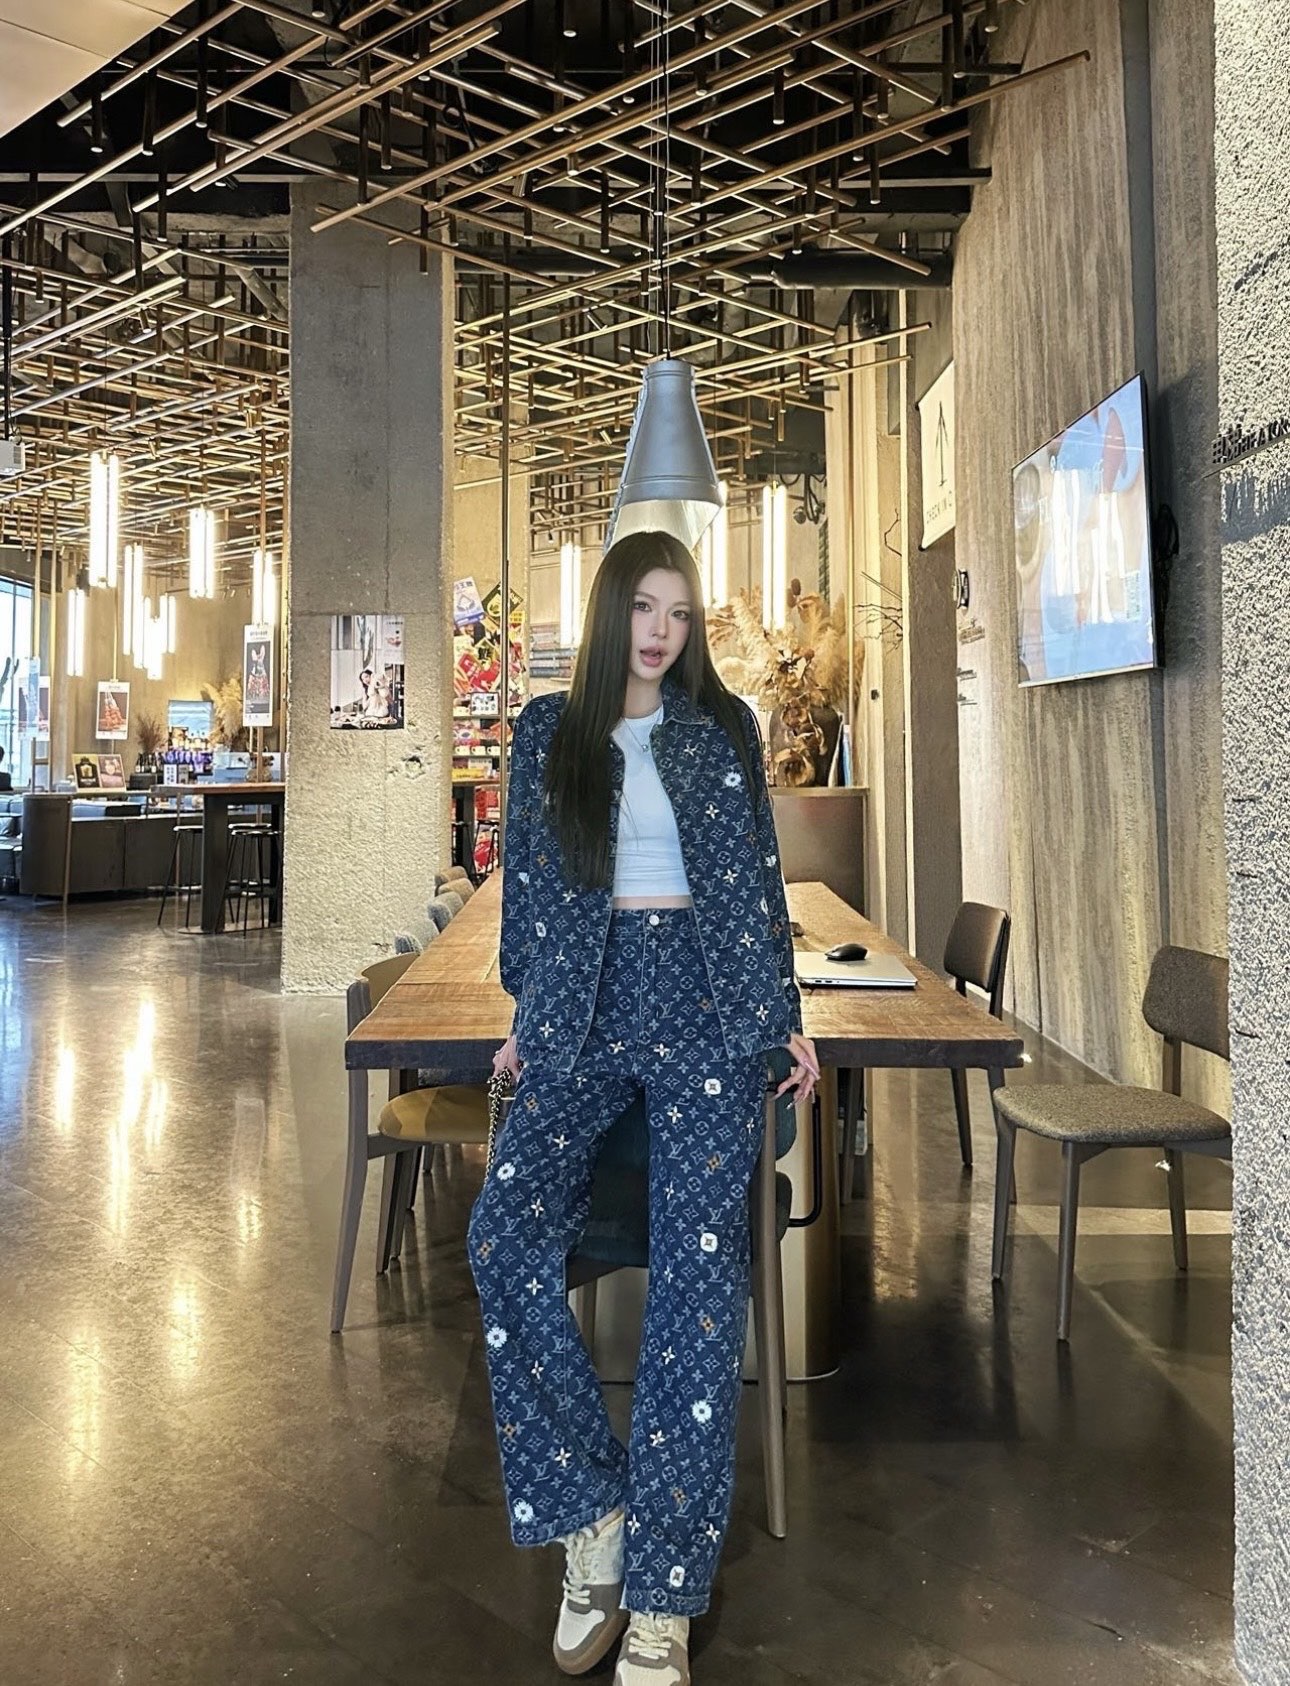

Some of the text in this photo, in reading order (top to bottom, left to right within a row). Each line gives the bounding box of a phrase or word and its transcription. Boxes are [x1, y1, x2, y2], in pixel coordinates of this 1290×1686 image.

[732, 818, 748, 836] LV
[702, 878, 718, 896] LV
[746, 870, 760, 887] LV
[716, 930, 732, 949] LV
[657, 948, 673, 965] LV
[541, 994, 558, 1014] LV
[659, 1001, 675, 1019] LV
[709, 1046, 726, 1062] LV
[667, 1141, 684, 1160] LV
[500, 1216, 521, 1236] LV
[708, 1208, 725, 1225] LV
[707, 1264, 724, 1282] LV
[503, 1276, 518, 1296] LV
[704, 1383, 720, 1403] LV
[521, 1399, 541, 1421] LV
[532, 1461, 551, 1482] LV
[628, 1552, 645, 1571] LV
